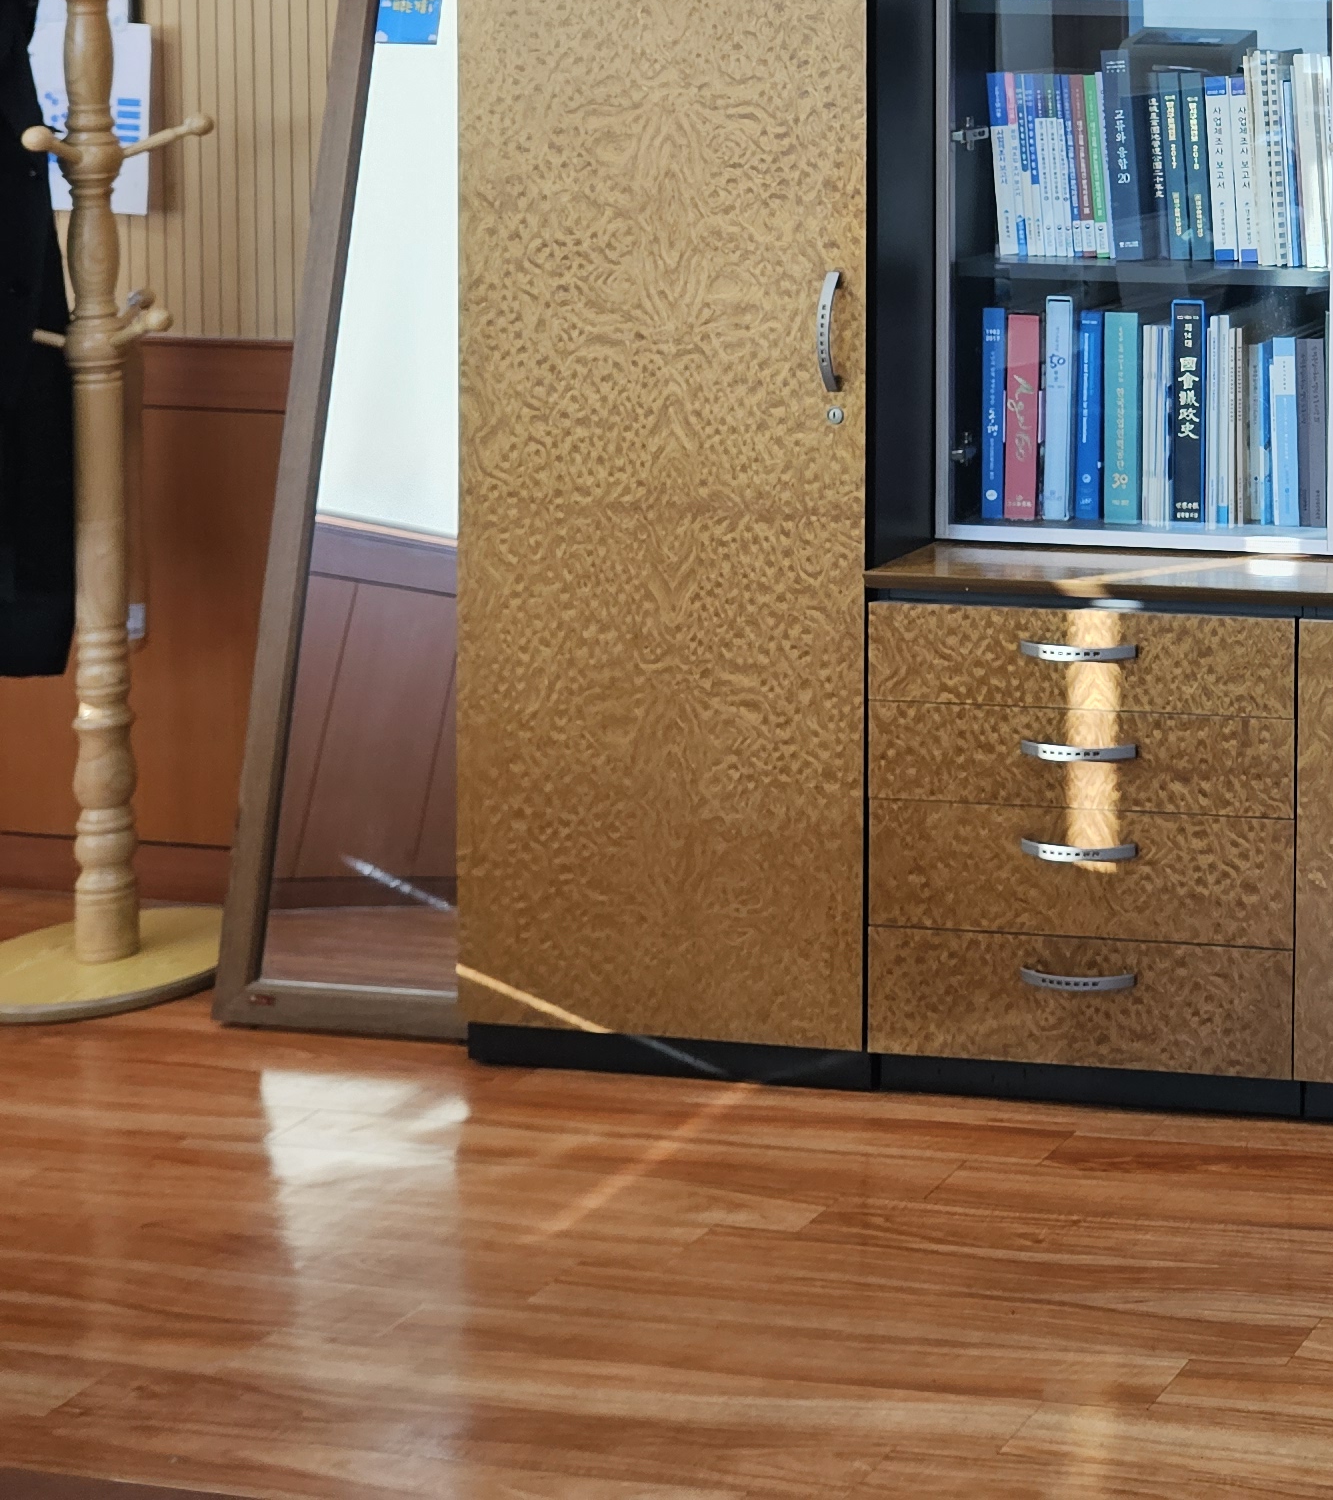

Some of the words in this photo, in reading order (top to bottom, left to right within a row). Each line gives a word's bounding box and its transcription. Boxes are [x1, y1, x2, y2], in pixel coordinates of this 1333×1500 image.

[1113, 109, 1127, 145] 교류와
[1213, 106, 1224, 156] 사업체조사
[1237, 106, 1249, 156] 사업체조사
[1116, 146, 1128, 171] 융합
[1117, 173, 1131, 185] 20
[1215, 160, 1226, 190] 보고서
[1240, 160, 1251, 190] 보고서
[1048, 353, 1066, 370] 50
